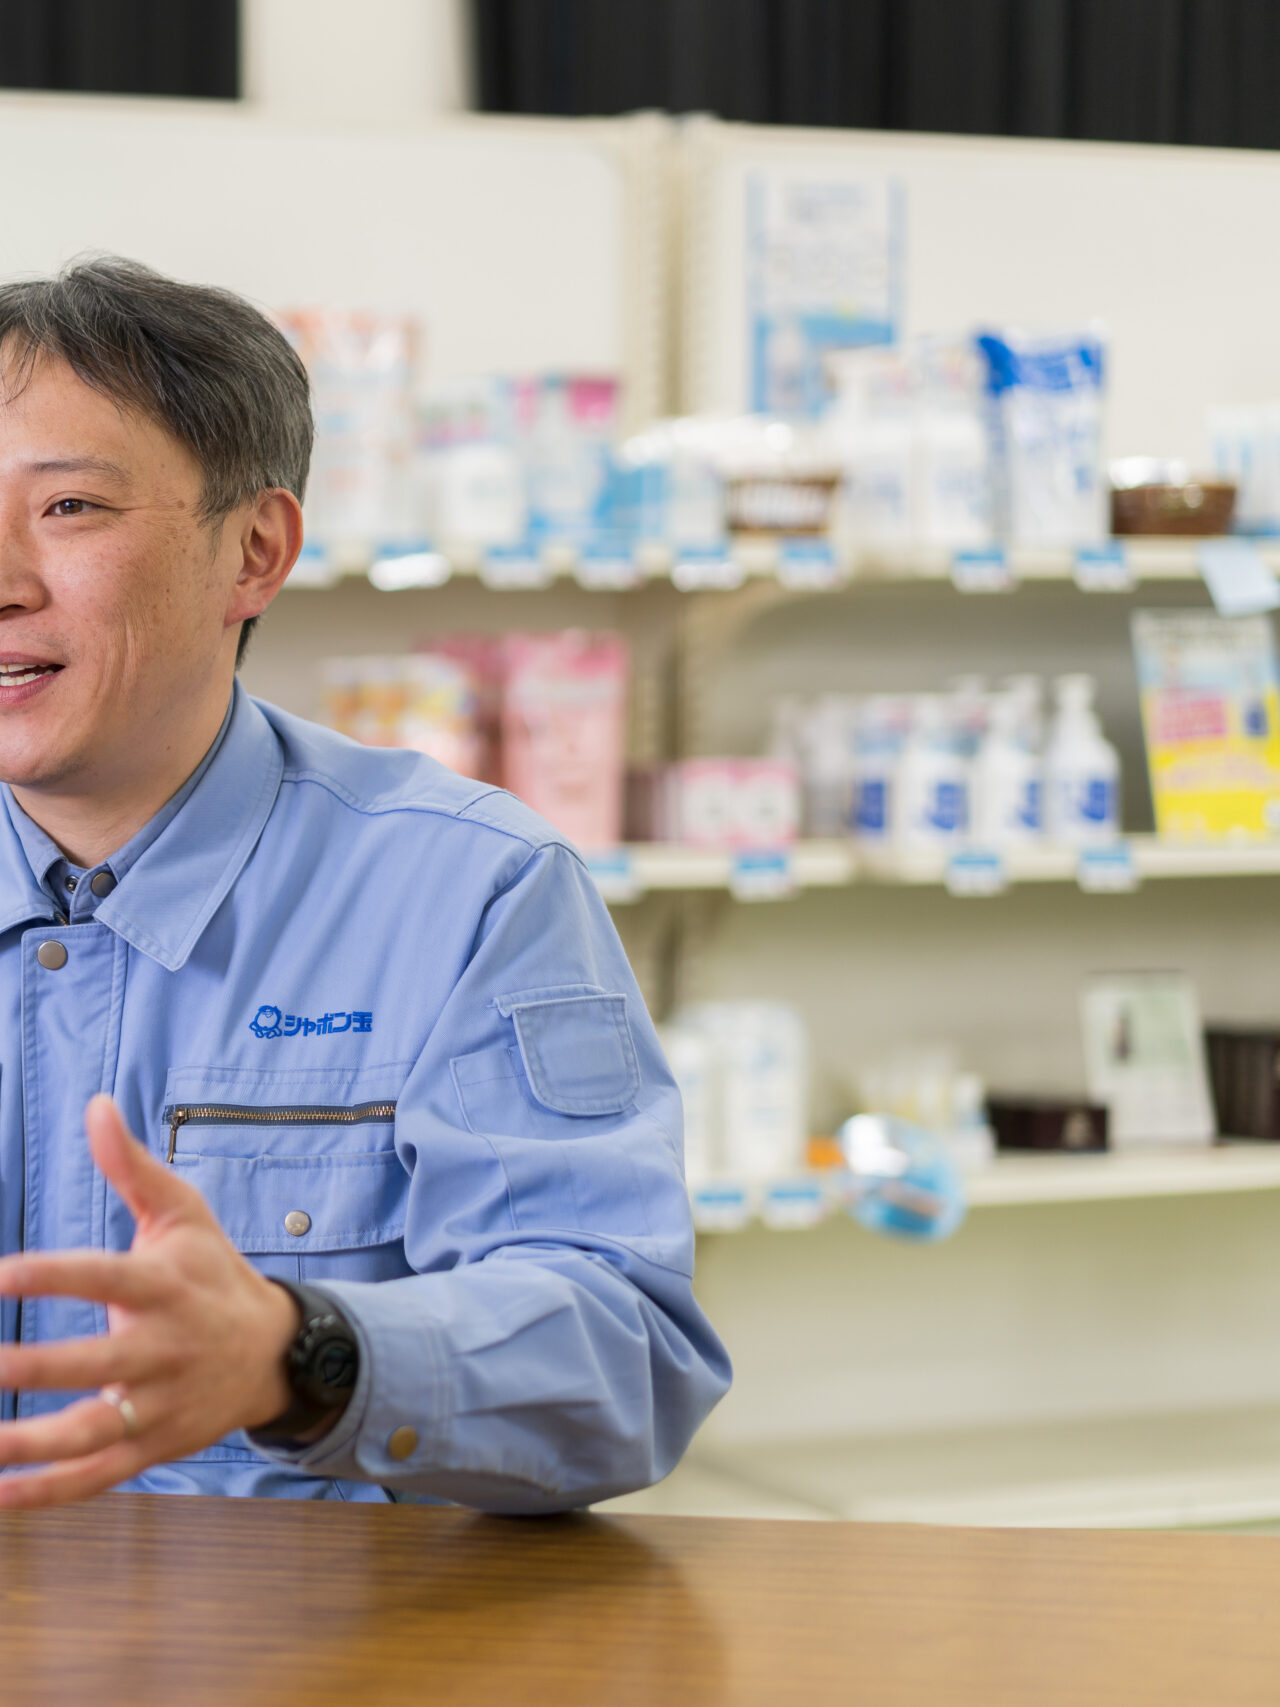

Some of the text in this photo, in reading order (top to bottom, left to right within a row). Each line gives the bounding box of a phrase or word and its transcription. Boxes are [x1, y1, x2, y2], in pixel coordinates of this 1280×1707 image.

[283, 1011, 373, 1037] シャボン玉
